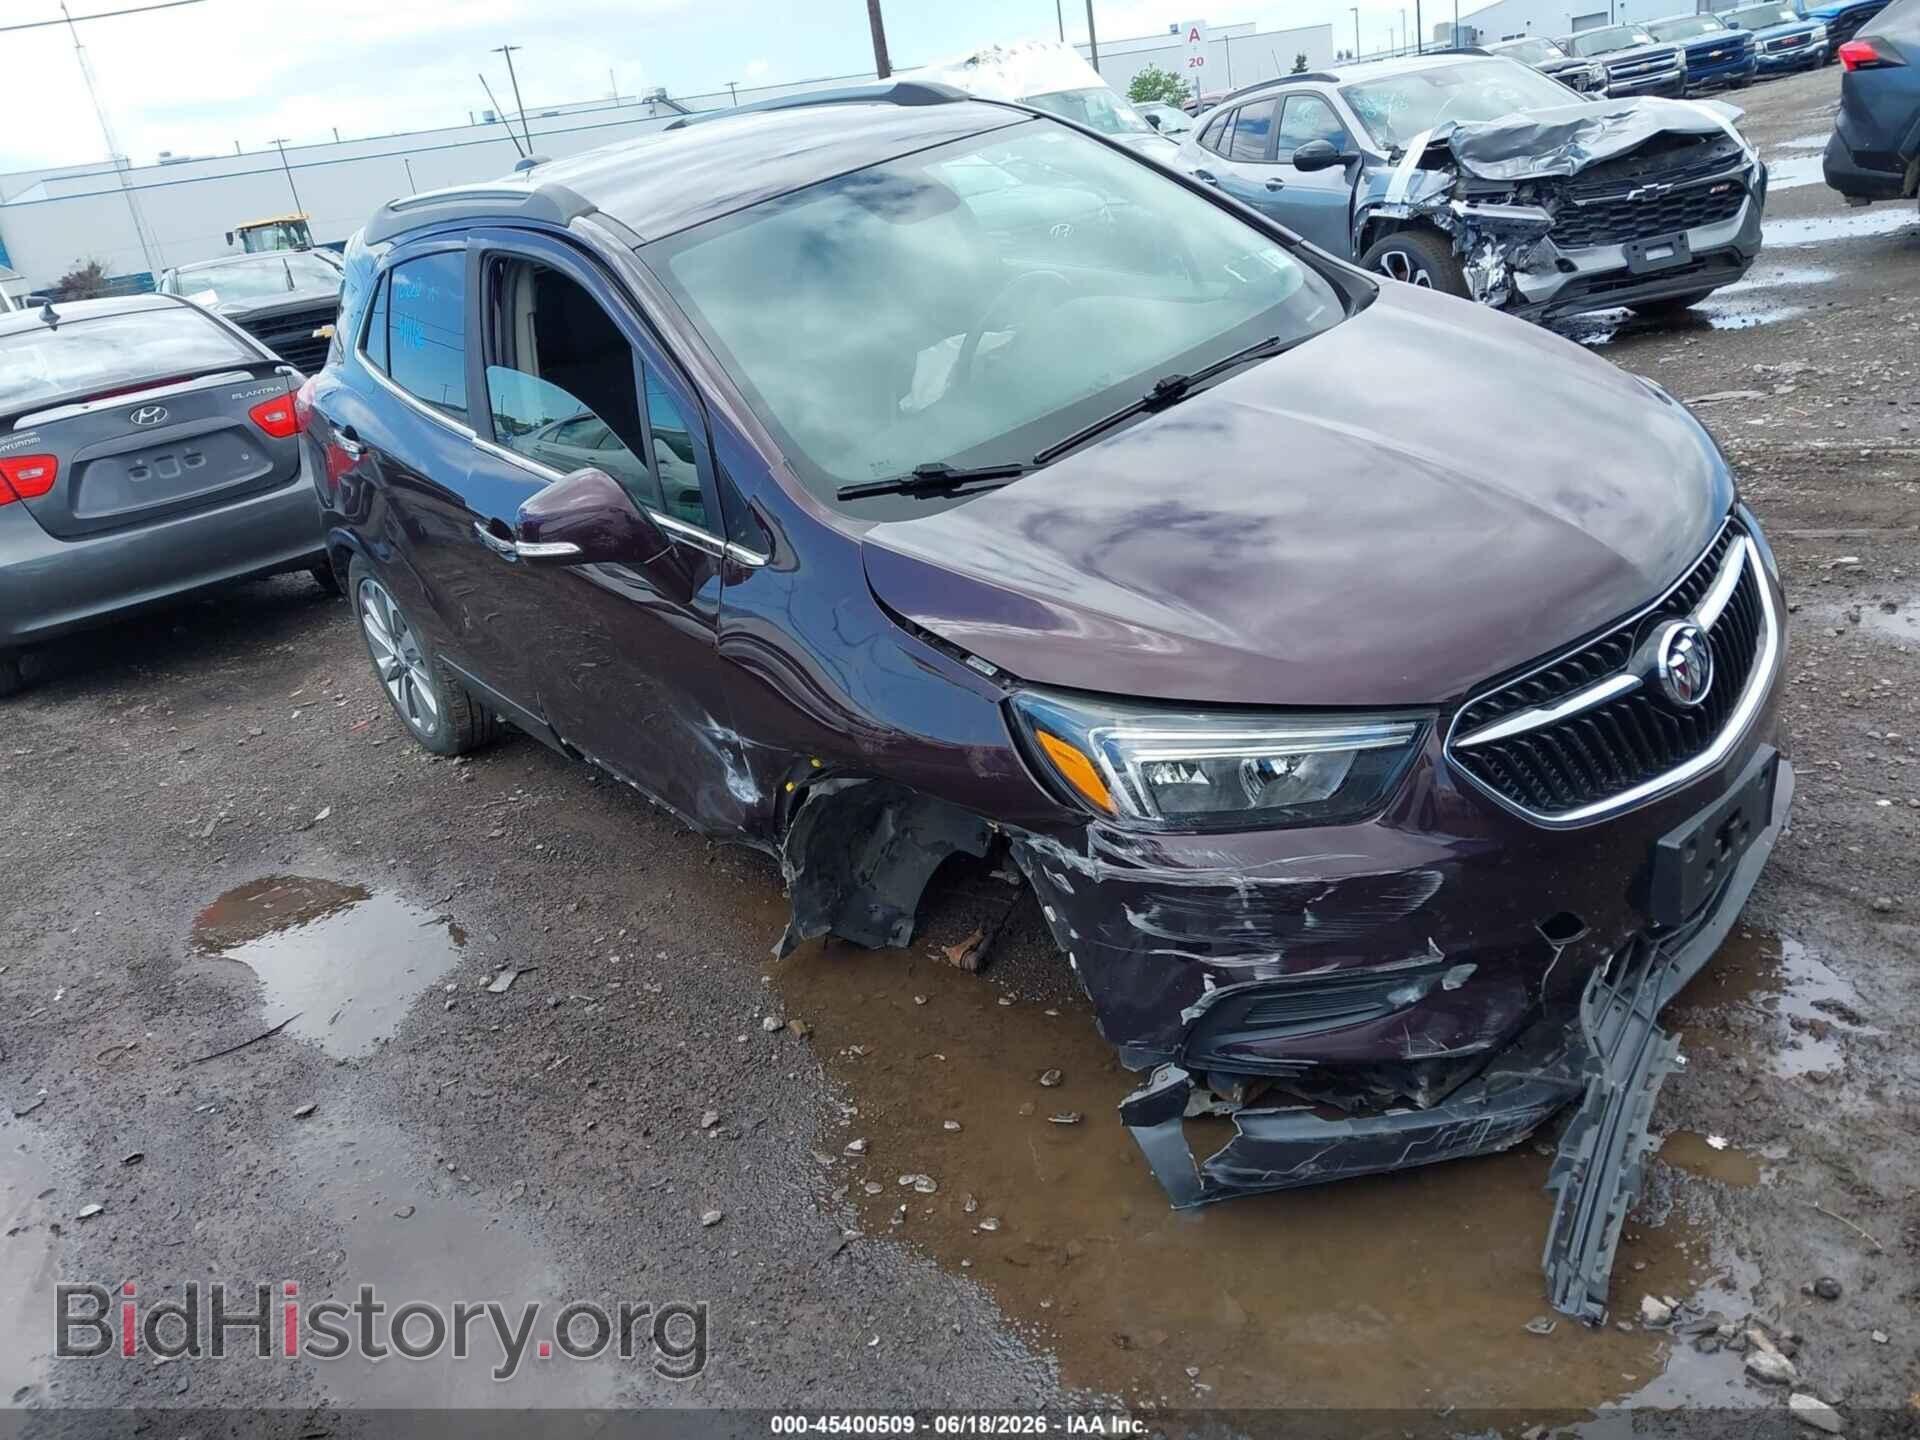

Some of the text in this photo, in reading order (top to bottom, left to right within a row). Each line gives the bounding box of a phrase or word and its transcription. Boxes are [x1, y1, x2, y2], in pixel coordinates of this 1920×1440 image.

[1189, 27, 1201, 43] A
[1188, 56, 1205, 68] 20
[231, 385, 282, 400] ELANTRA
